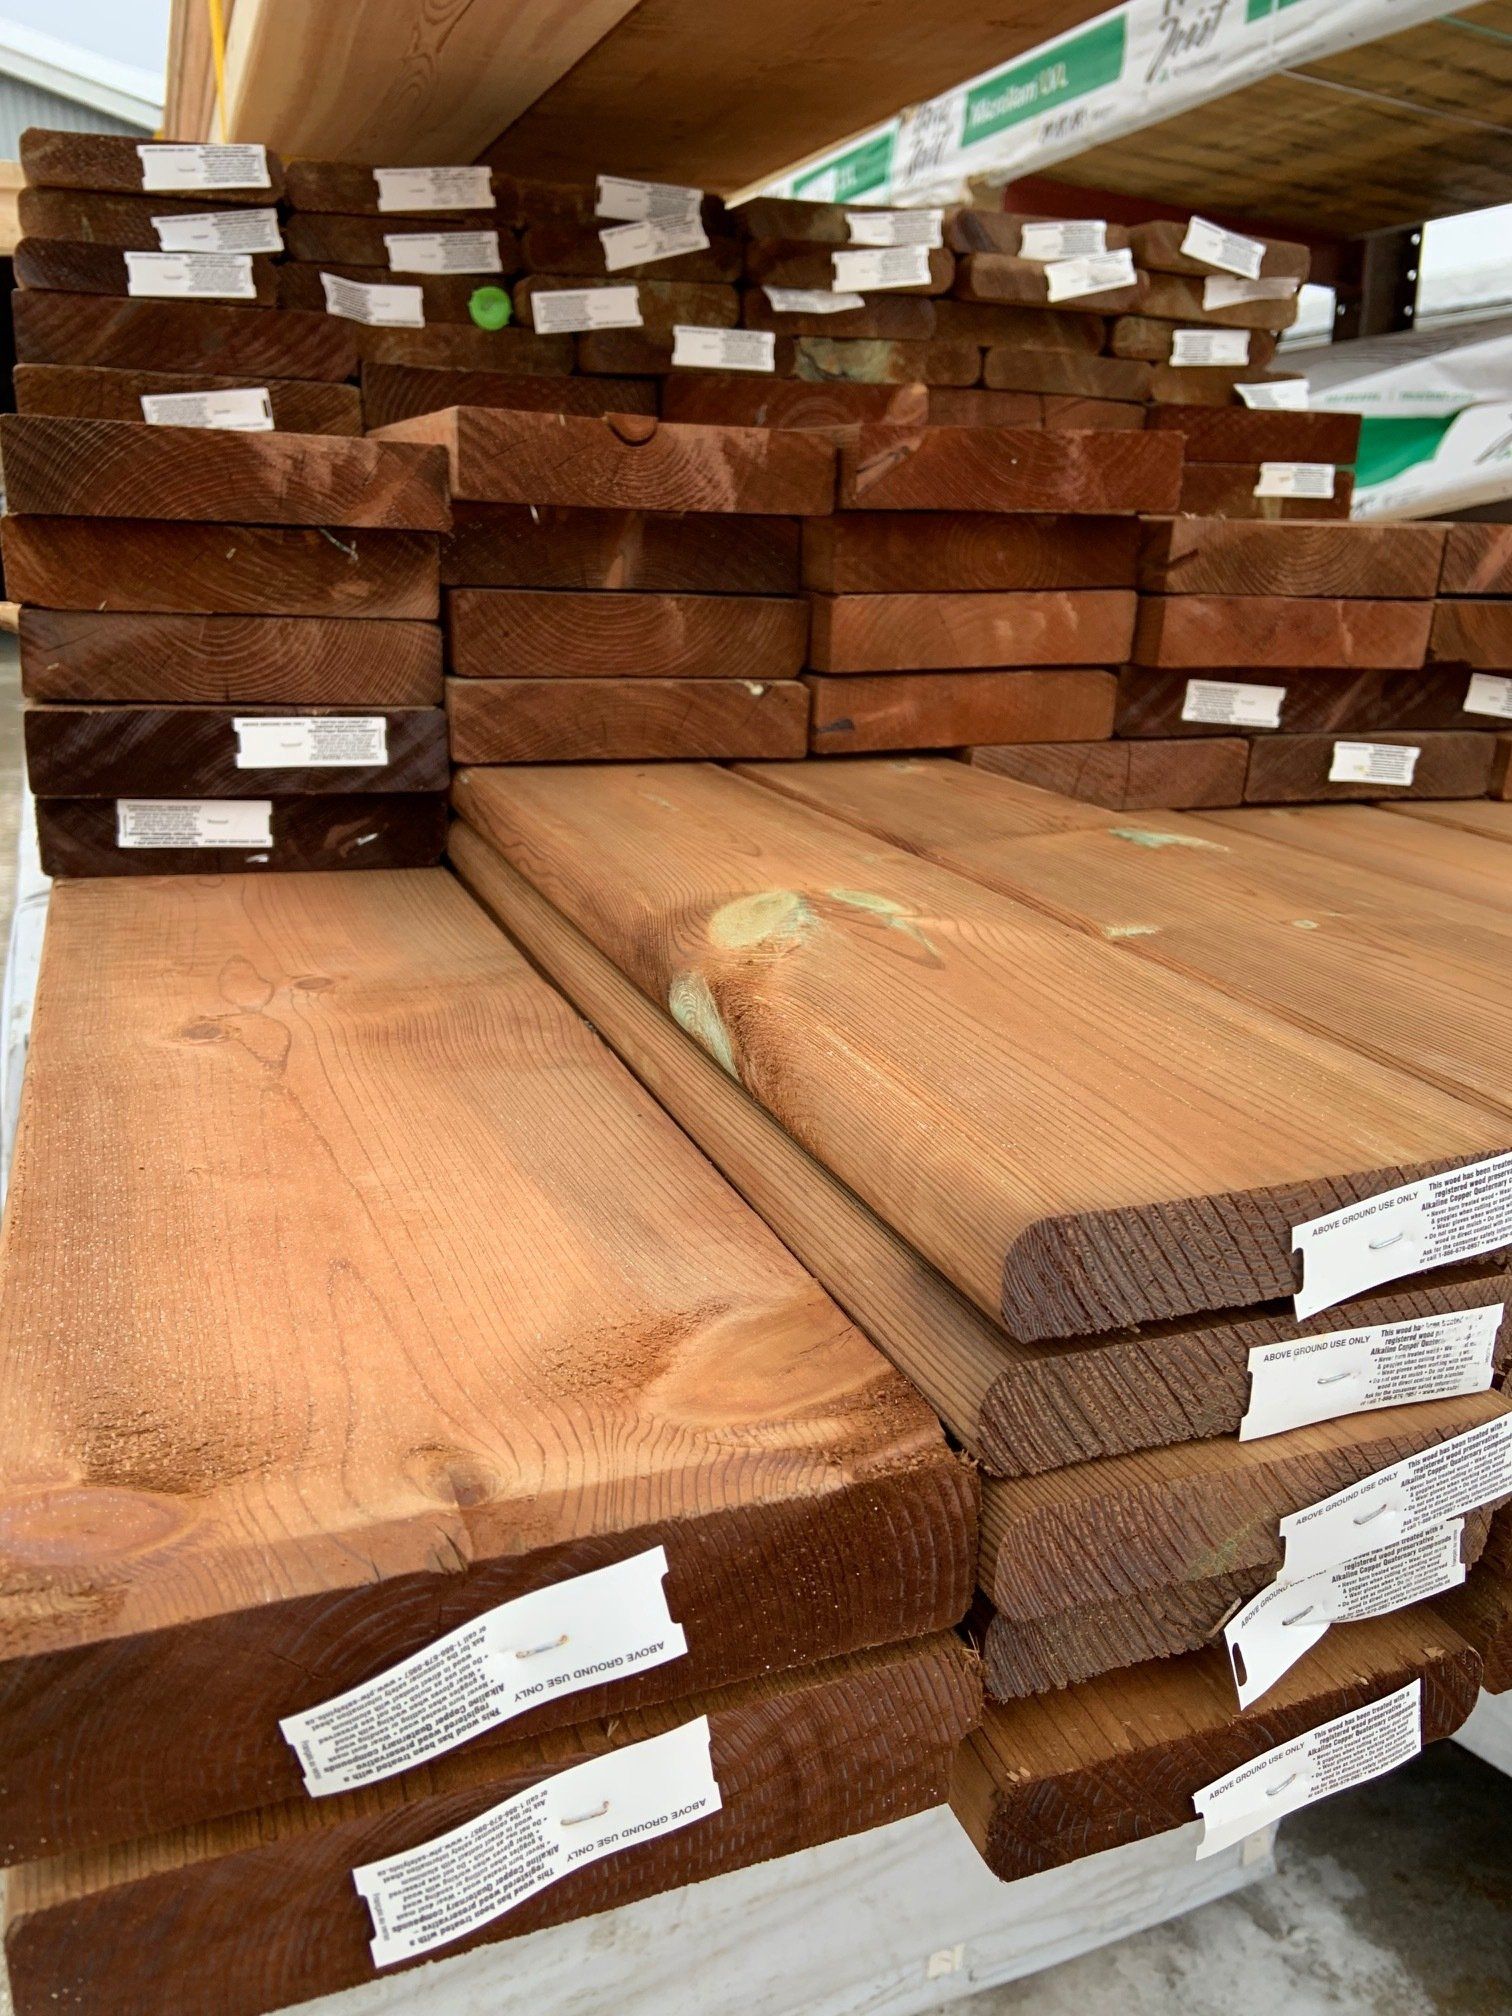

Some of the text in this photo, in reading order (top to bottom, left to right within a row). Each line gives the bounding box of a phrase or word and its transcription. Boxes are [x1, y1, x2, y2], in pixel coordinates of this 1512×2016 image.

[1429, 1158, 1512, 1191] This wood has been treate
[1434, 1181, 1468, 1199] registered
[1469, 1175, 1486, 1188] wood
[1421, 1178, 1507, 1212] Alkaline Copper Quaternary
[1312, 1191, 1418, 1237] ABOVE GROUND USE ONLY
[1381, 1324, 1421, 1338] This wood ha
[1384, 1330, 1434, 1347] registered wood
[1264, 1335, 1371, 1363] ABOVE GROUND USE ONLY
[1370, 1343, 1396, 1356] Alkaline
[1408, 1459, 1421, 1469] This
[1421, 1449, 1438, 1463] wood
[1438, 1446, 1450, 1456] has
[1451, 1439, 1466, 1451] been
[1467, 1427, 1489, 1444] treated
[1489, 1422, 1502, 1433] with
[1413, 1432, 1499, 1475] registered wood preservative
[1400, 1471, 1426, 1488] Alkaline
[1427, 1462, 1448, 1477] Copper
[1449, 1446, 1482, 1467] Quaternary
[1296, 1471, 1399, 1525] ABOVE GROUND USE ONLY
[1401, 1530, 1424, 1545] treated
[1424, 1525, 1438, 1536] with
[1331, 1569, 1358, 1581] Alkaline
[1359, 1561, 1382, 1574] Copper
[1382, 1548, 1417, 1566] Quaternary
[1417, 1535, 1451, 1553] compounds
[1343, 1554, 1377, 1571] registered
[1378, 1548, 1396, 1560] wood
[1396, 1535, 1434, 1555] preservative
[514, 1641, 665, 1702] ABOVE GROUND USE ONLY
[468, 1682, 504, 1709] Alkaline
[434, 1704, 466, 1726] Copper
[443, 1701, 490, 1733] registered
[1307, 1700, 1416, 1757] Alkaline Copper Quaternary compounds
[1314, 1729, 1327, 1740] This
[1327, 1721, 1344, 1734] wood
[1344, 1717, 1355, 1727] has
[1356, 1710, 1371, 1722] been
[1371, 1699, 1393, 1715] treated
[1393, 1692, 1405, 1704] with
[1319, 1702, 1402, 1745] registered wood preservative
[343, 1706, 499, 1783] This wood has been treated with a
[381, 1722, 433, 1752] Quaternary
[416, 1728, 442, 1746] wood
[323, 1748, 379, 1773] compounds
[355, 1739, 415, 1770] preservative
[1209, 1742, 1305, 1801] ABOVE GROUND USE ONLY
[567, 1798, 706, 1862] ABOVE GROUND USE ONLY
[525, 1843, 559, 1868] Alkaline
[495, 1864, 524, 1886] Copper
[502, 1862, 545, 1894] registered
[409, 1867, 554, 1947] This wood has been treated with a
[445, 1882, 493, 1912] Quaternary
[478, 1888, 501, 1907] wood
[391, 1908, 444, 1933] compounds
[421, 1900, 477, 1932] preservative
